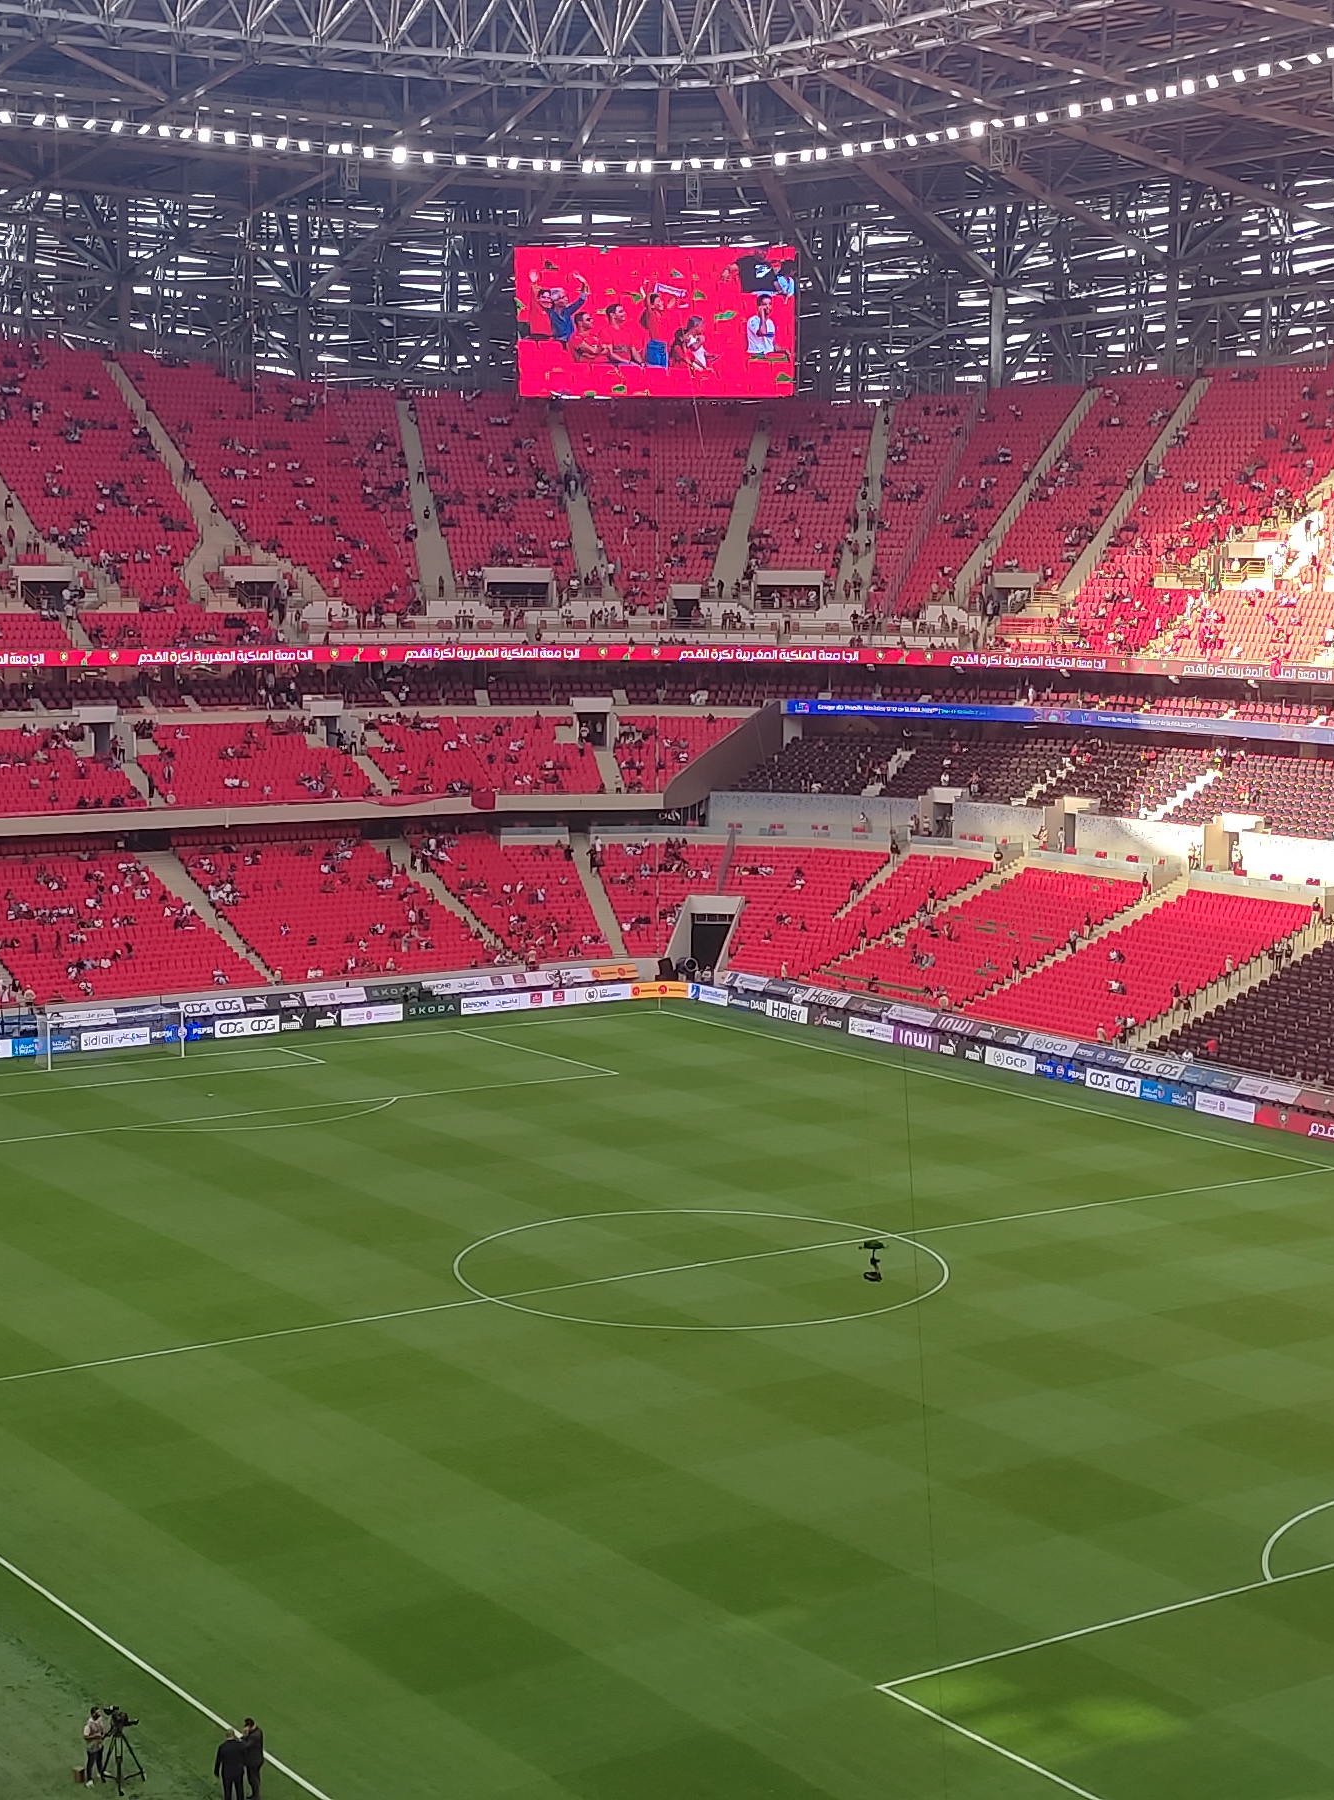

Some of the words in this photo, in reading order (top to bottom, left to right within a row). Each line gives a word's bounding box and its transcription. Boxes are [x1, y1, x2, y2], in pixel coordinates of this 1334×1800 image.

[809, 990, 843, 1005] Haier
[409, 1004, 455, 1015] SKODA
[772, 1002, 801, 1021] Haier
[219, 1022, 245, 1034] CDG
[251, 1019, 276, 1032] CDG
[1045, 1041, 1067, 1052] OCP
[1006, 1056, 1027, 1067] OCP
